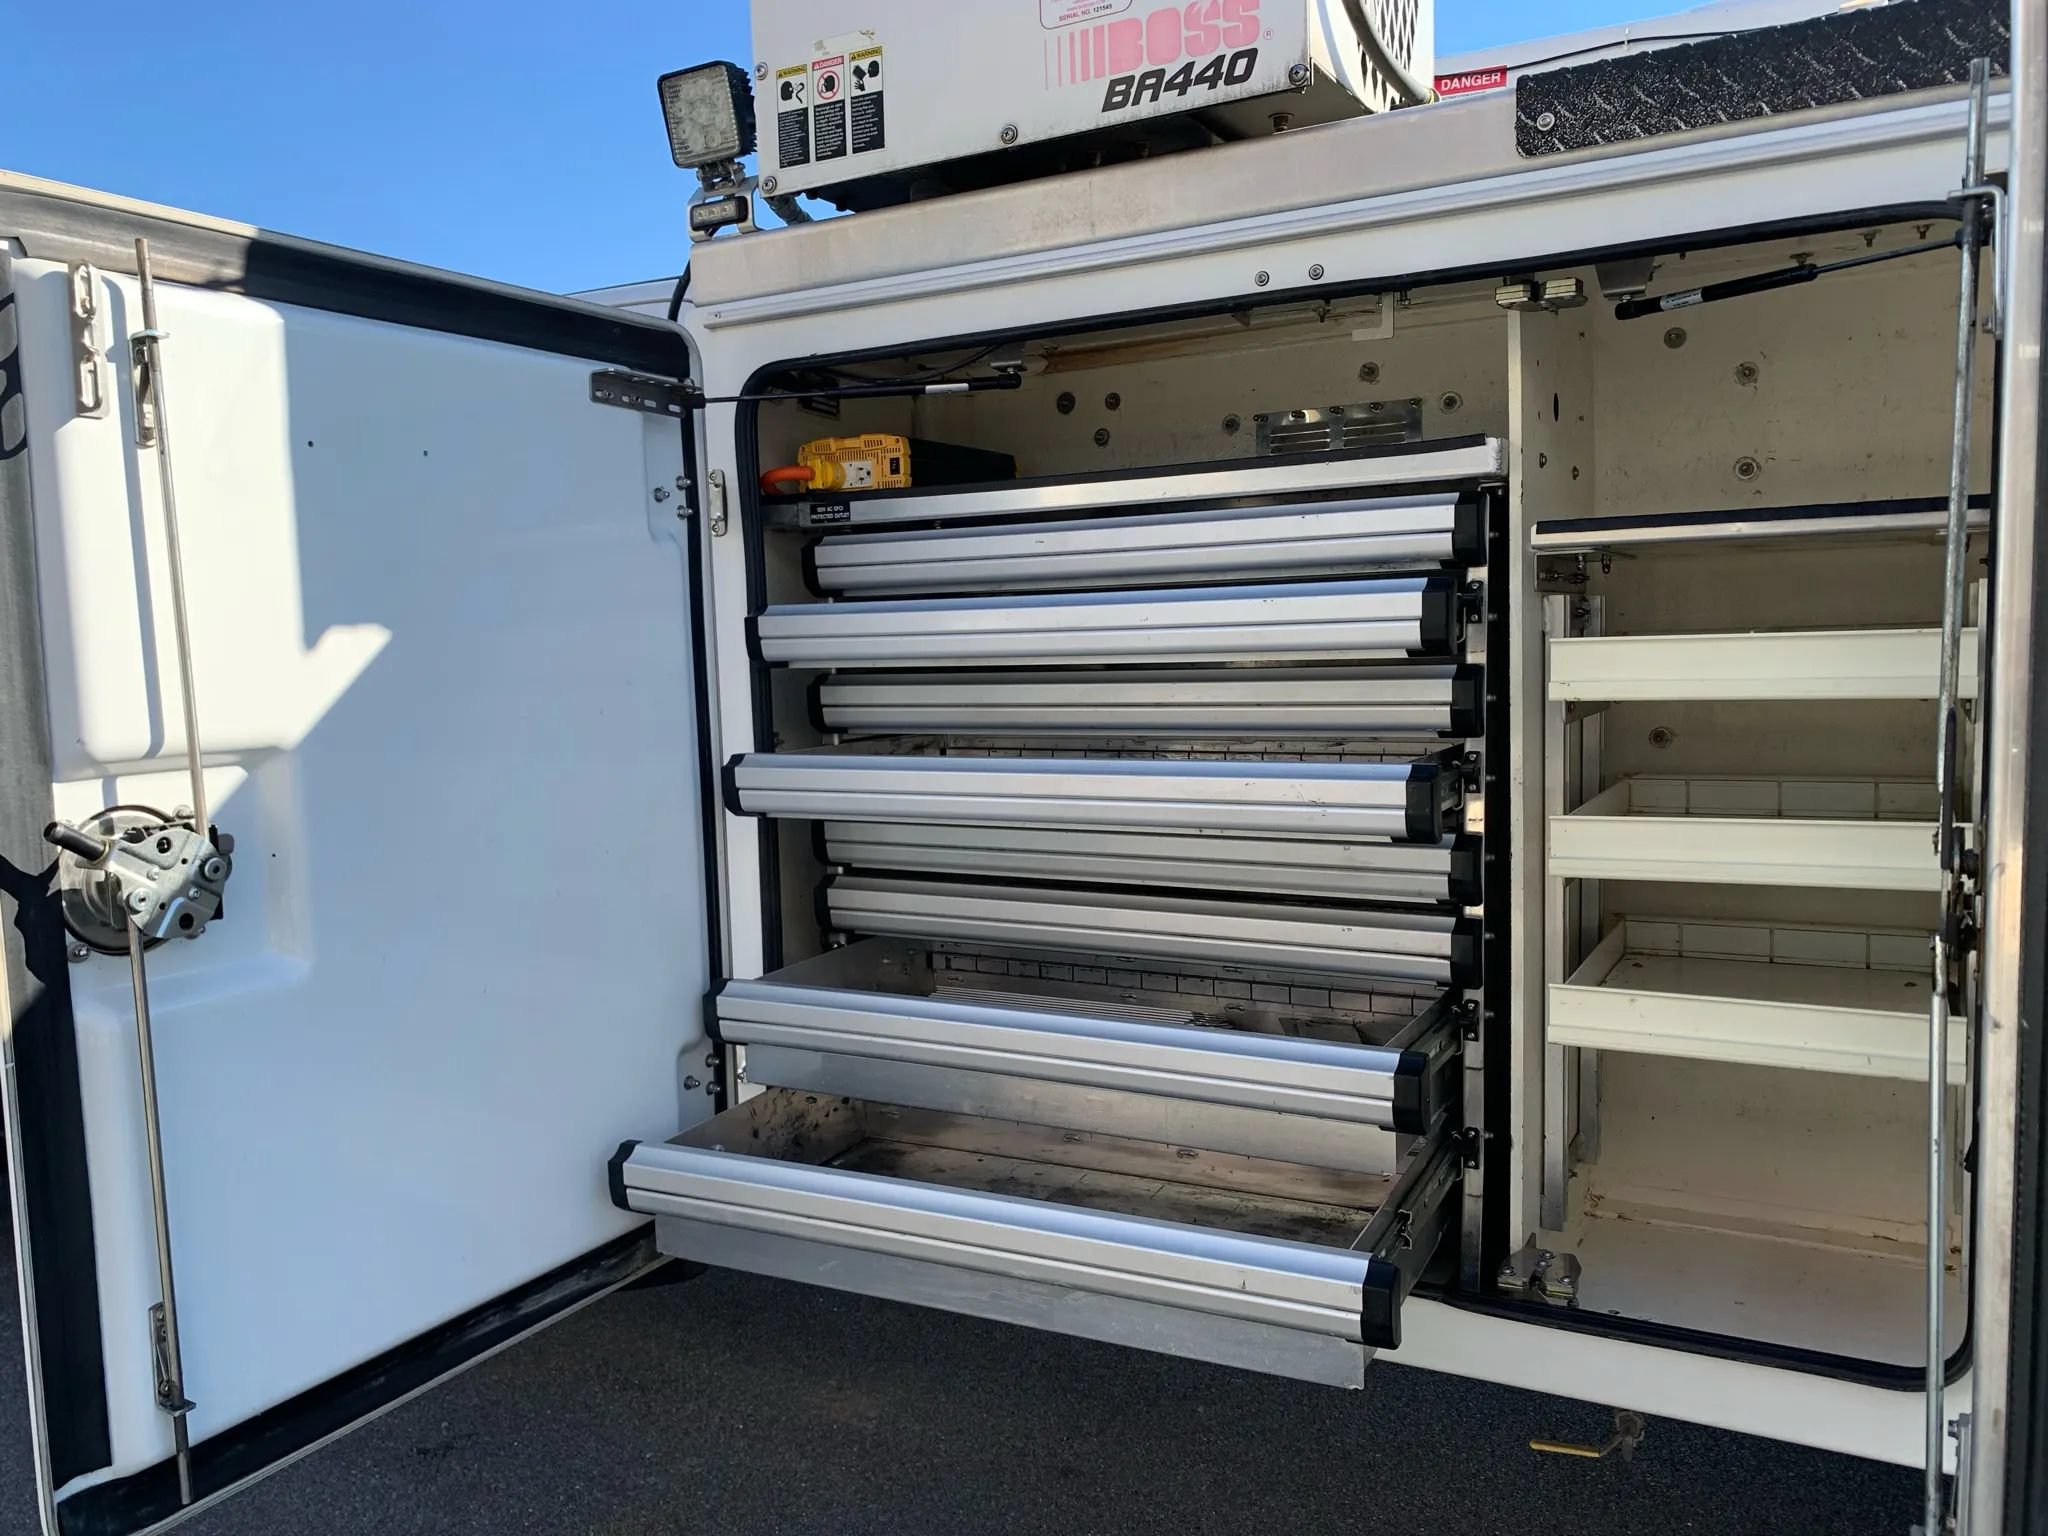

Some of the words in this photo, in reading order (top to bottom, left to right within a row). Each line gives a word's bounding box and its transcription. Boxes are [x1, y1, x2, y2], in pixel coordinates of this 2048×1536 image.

[1058, 12, 1080, 22] SERIAL
[1108, 0, 1260, 76] BOSS
[856, 47, 881, 59] WARNING
[820, 57, 842, 69] DANGER
[783, 65, 805, 76] WARNING
[1101, 47, 1259, 113] BA440
[1441, 72, 1501, 91] DANGER
